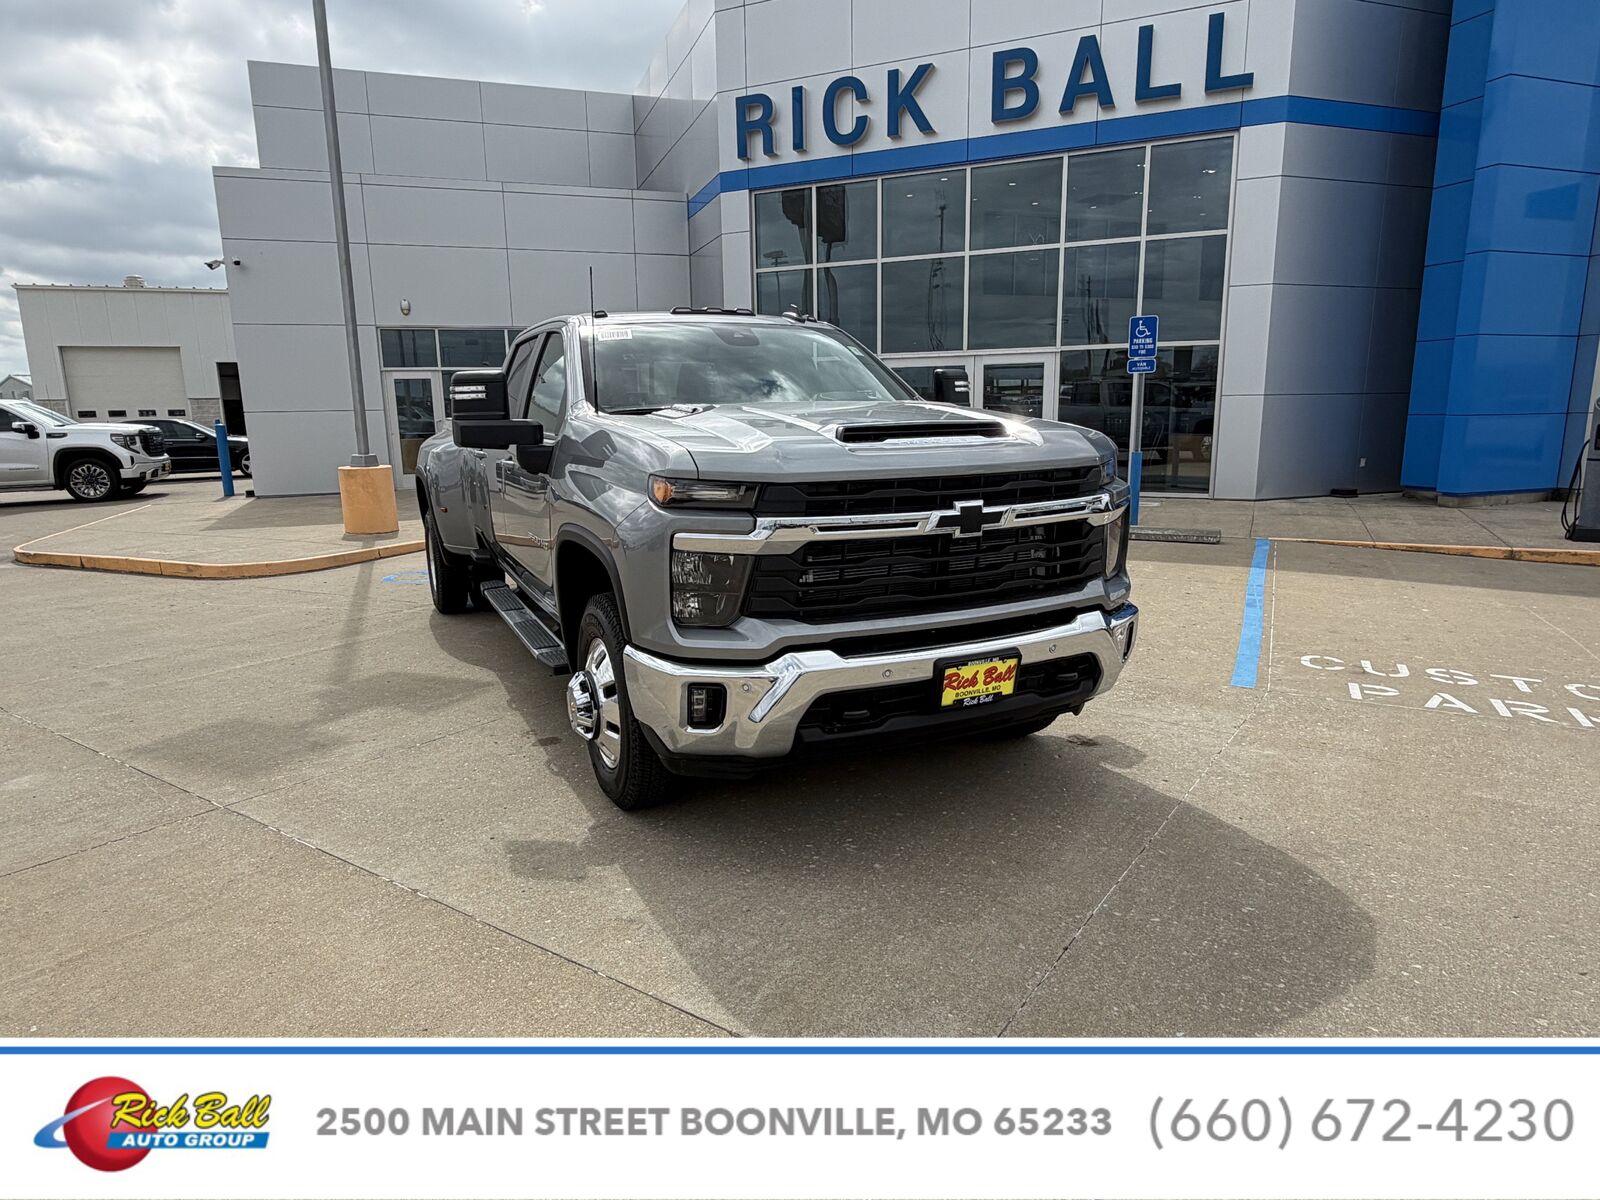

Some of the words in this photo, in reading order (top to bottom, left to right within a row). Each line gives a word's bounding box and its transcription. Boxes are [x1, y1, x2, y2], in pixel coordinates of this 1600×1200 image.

[735, 63, 936, 160] RICK
[991, 12, 1255, 124] BALL
[943, 669, 979, 692] Rick
[983, 663, 1017, 686] Ball
[963, 697, 979, 707] Rick
[979, 694, 994, 704] Ball
